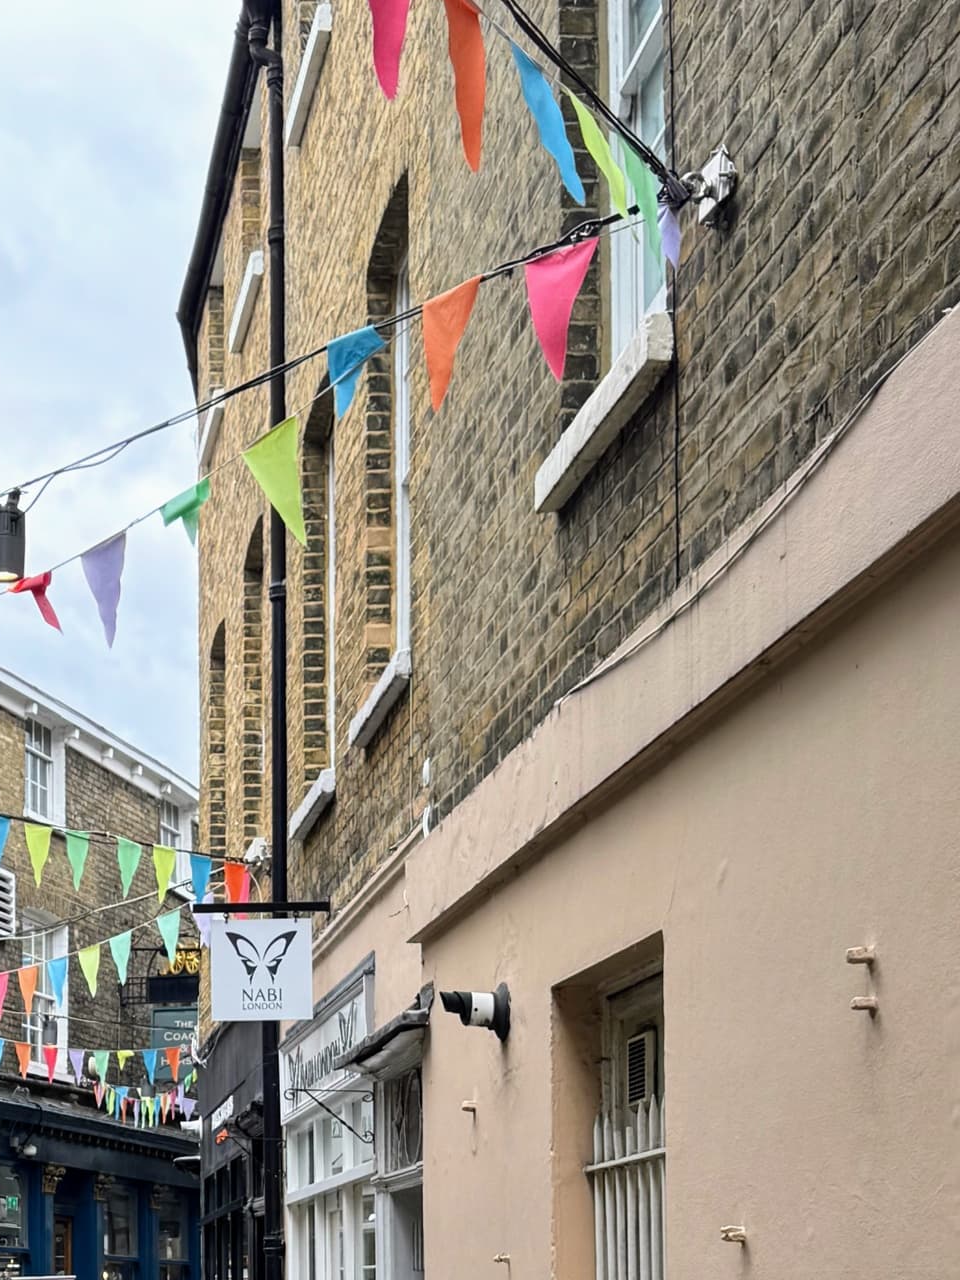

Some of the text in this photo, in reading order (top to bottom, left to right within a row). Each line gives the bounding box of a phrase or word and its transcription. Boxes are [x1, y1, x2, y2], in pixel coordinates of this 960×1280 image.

[241, 988, 282, 1001] NABI
[242, 1002, 283, 1010] LONDON
[174, 1020, 194, 1028] THE
